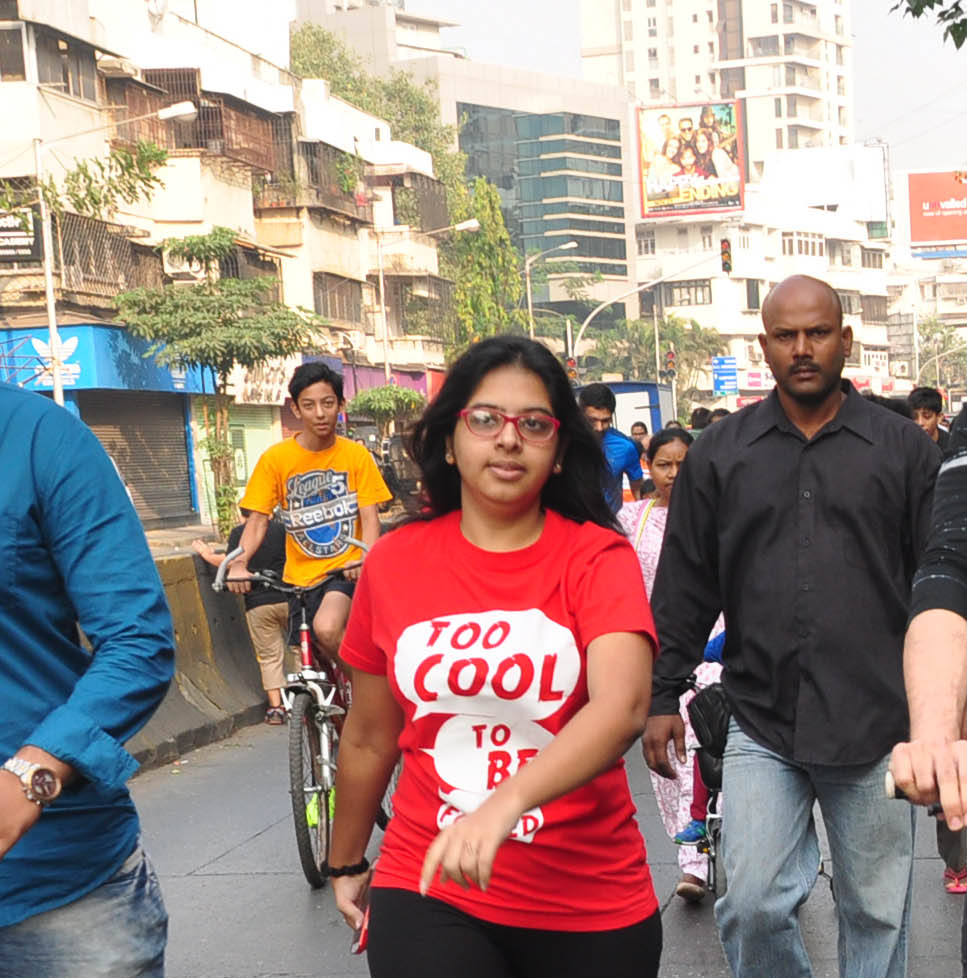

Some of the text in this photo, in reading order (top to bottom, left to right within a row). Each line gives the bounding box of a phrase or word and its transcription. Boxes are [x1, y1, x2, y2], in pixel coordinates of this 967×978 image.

[327, 474, 345, 496] 5
[290, 500, 357, 528] Reebok
[427, 620, 511, 650] TOO
[413, 652, 565, 703] COOL
[471, 724, 511, 748] TO
